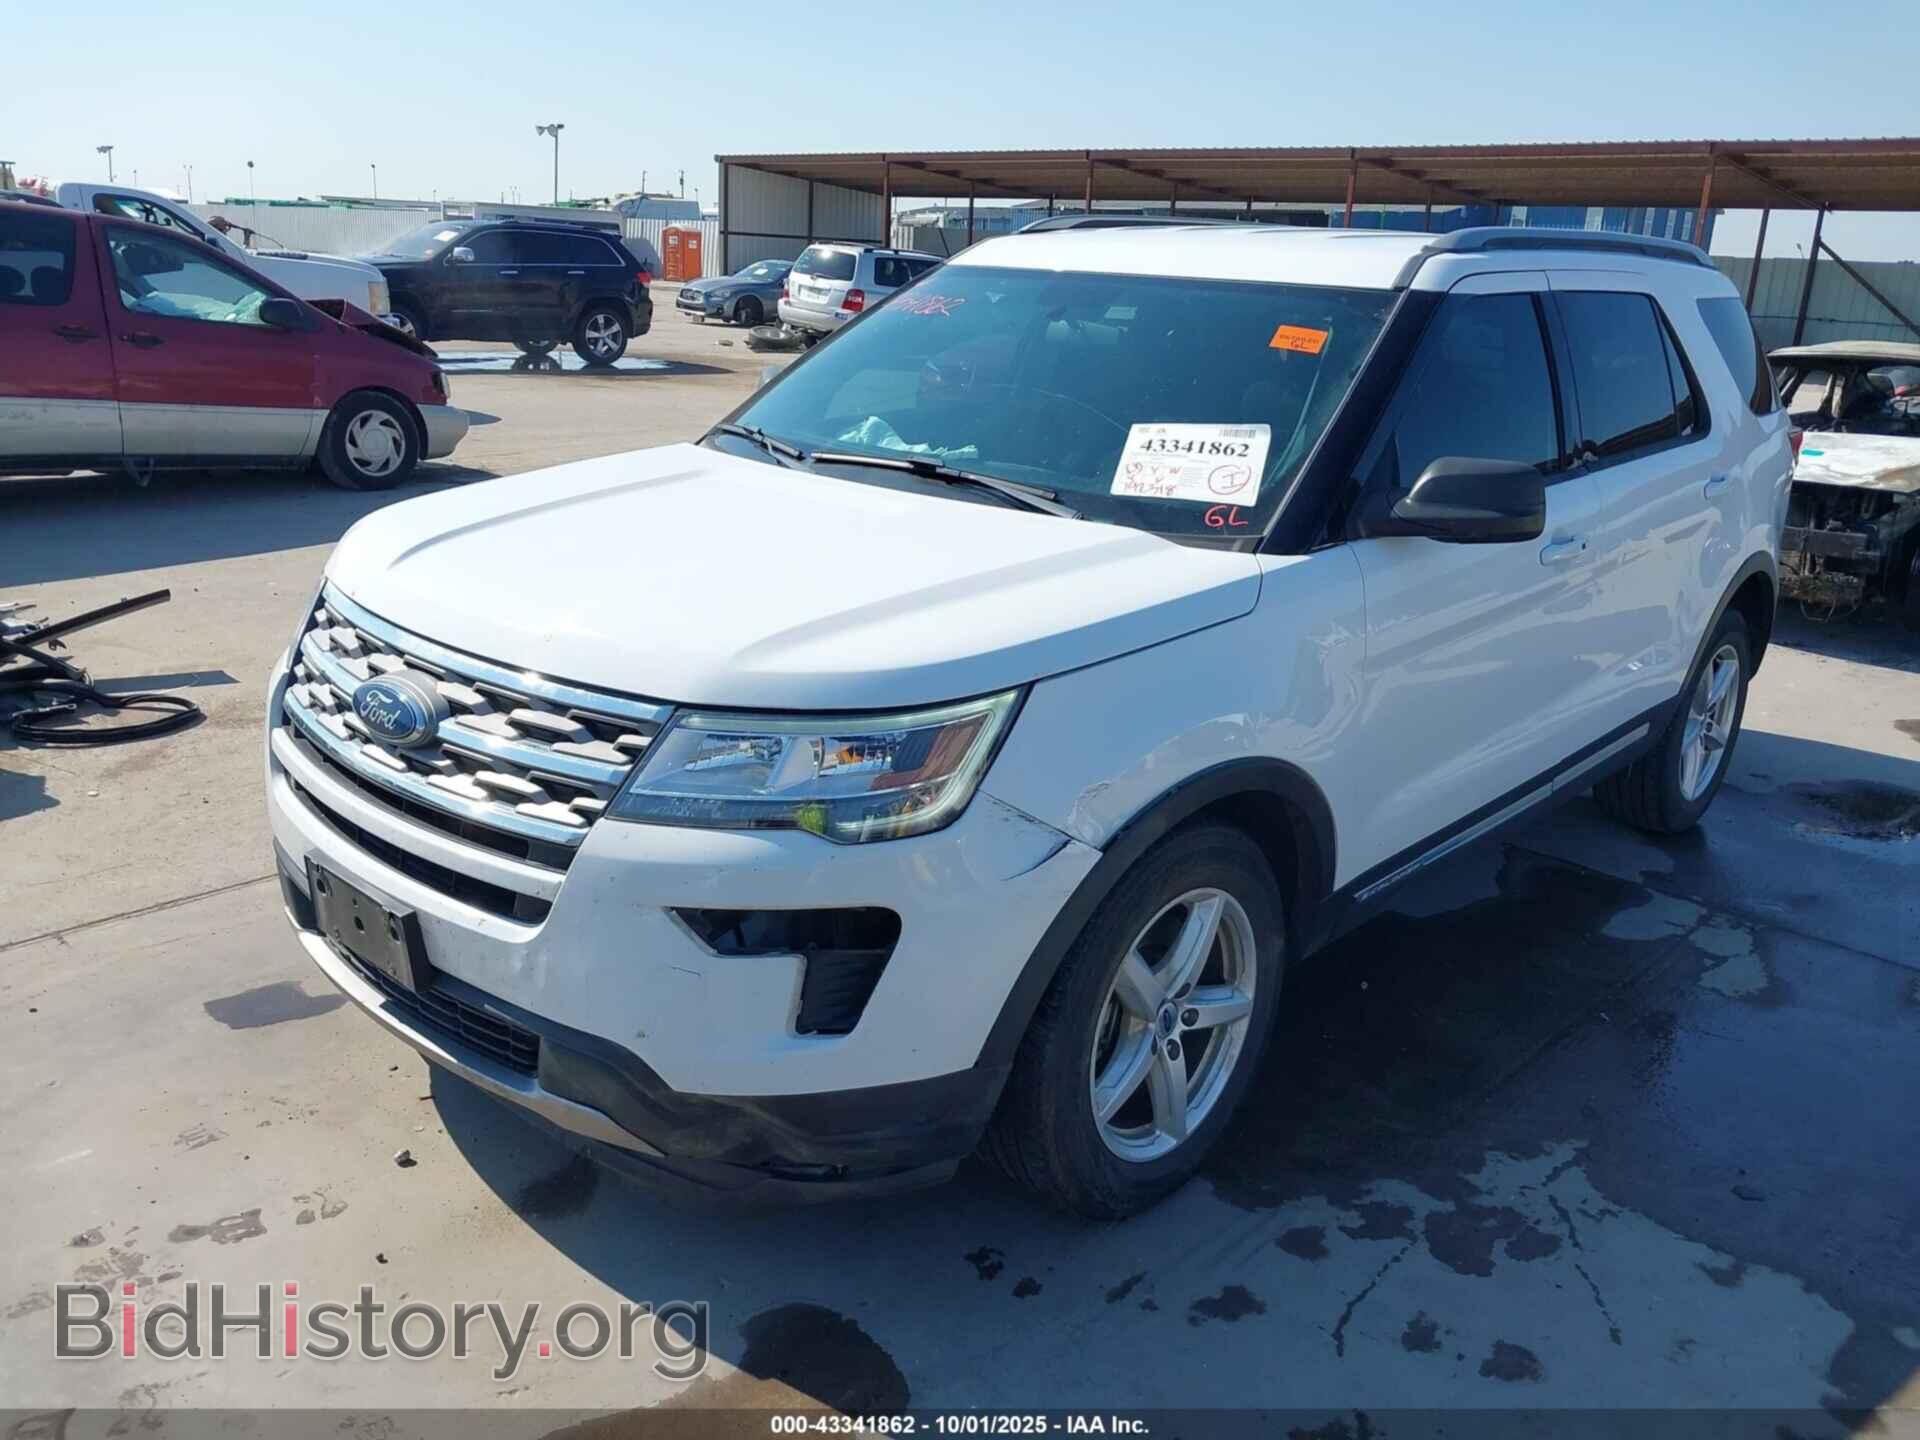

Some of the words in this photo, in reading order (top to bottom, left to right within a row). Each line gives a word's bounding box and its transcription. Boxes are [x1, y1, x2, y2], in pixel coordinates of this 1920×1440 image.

[1140, 438, 1250, 458] 43341862
[1204, 504, 1248, 528] GL
[360, 690, 401, 730] Ford
